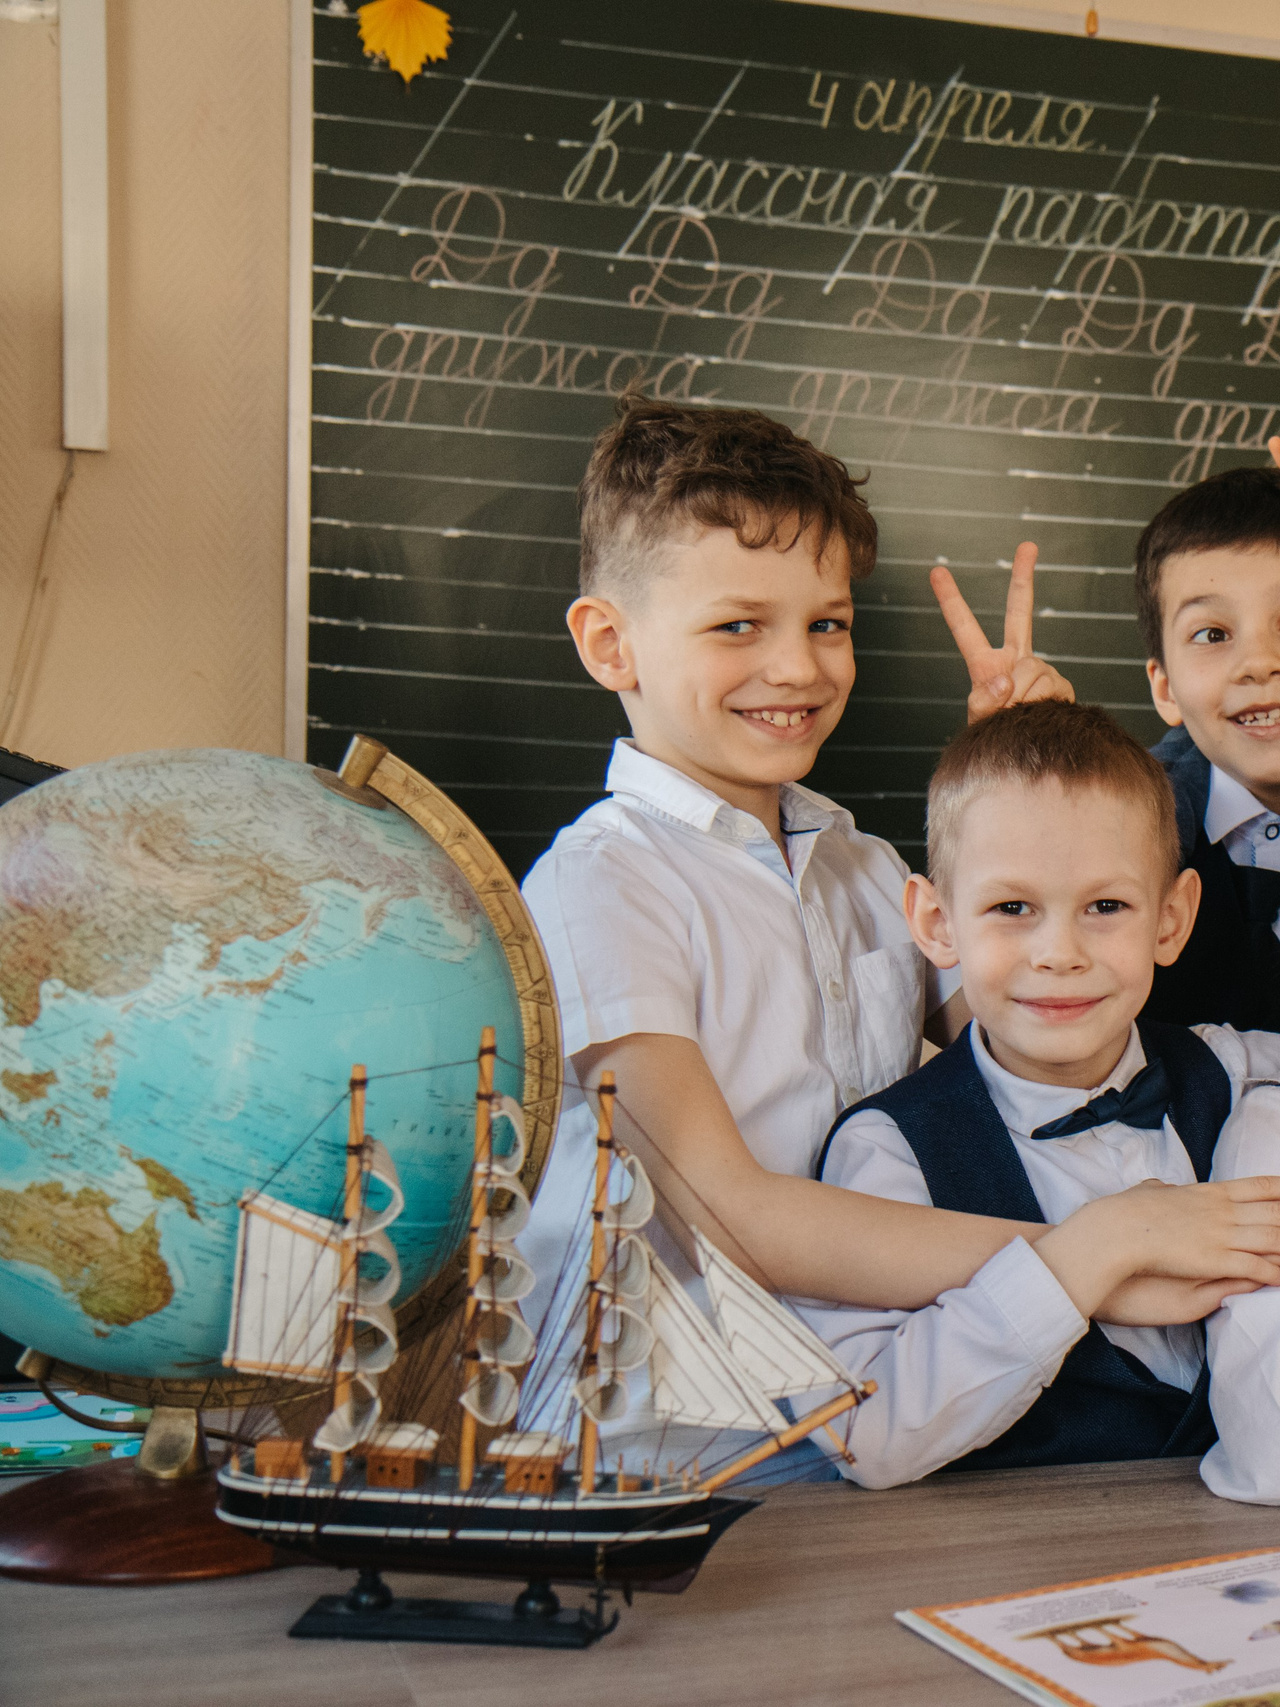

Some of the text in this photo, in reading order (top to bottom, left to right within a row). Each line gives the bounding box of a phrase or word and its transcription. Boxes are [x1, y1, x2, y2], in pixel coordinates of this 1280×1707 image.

[563, 99, 962, 234] Классная
[411, 185, 562, 338] Дд
[630, 215, 783, 362] Дд
[1061, 253, 1199, 399] Дд
[367, 312, 722, 428] дружба
